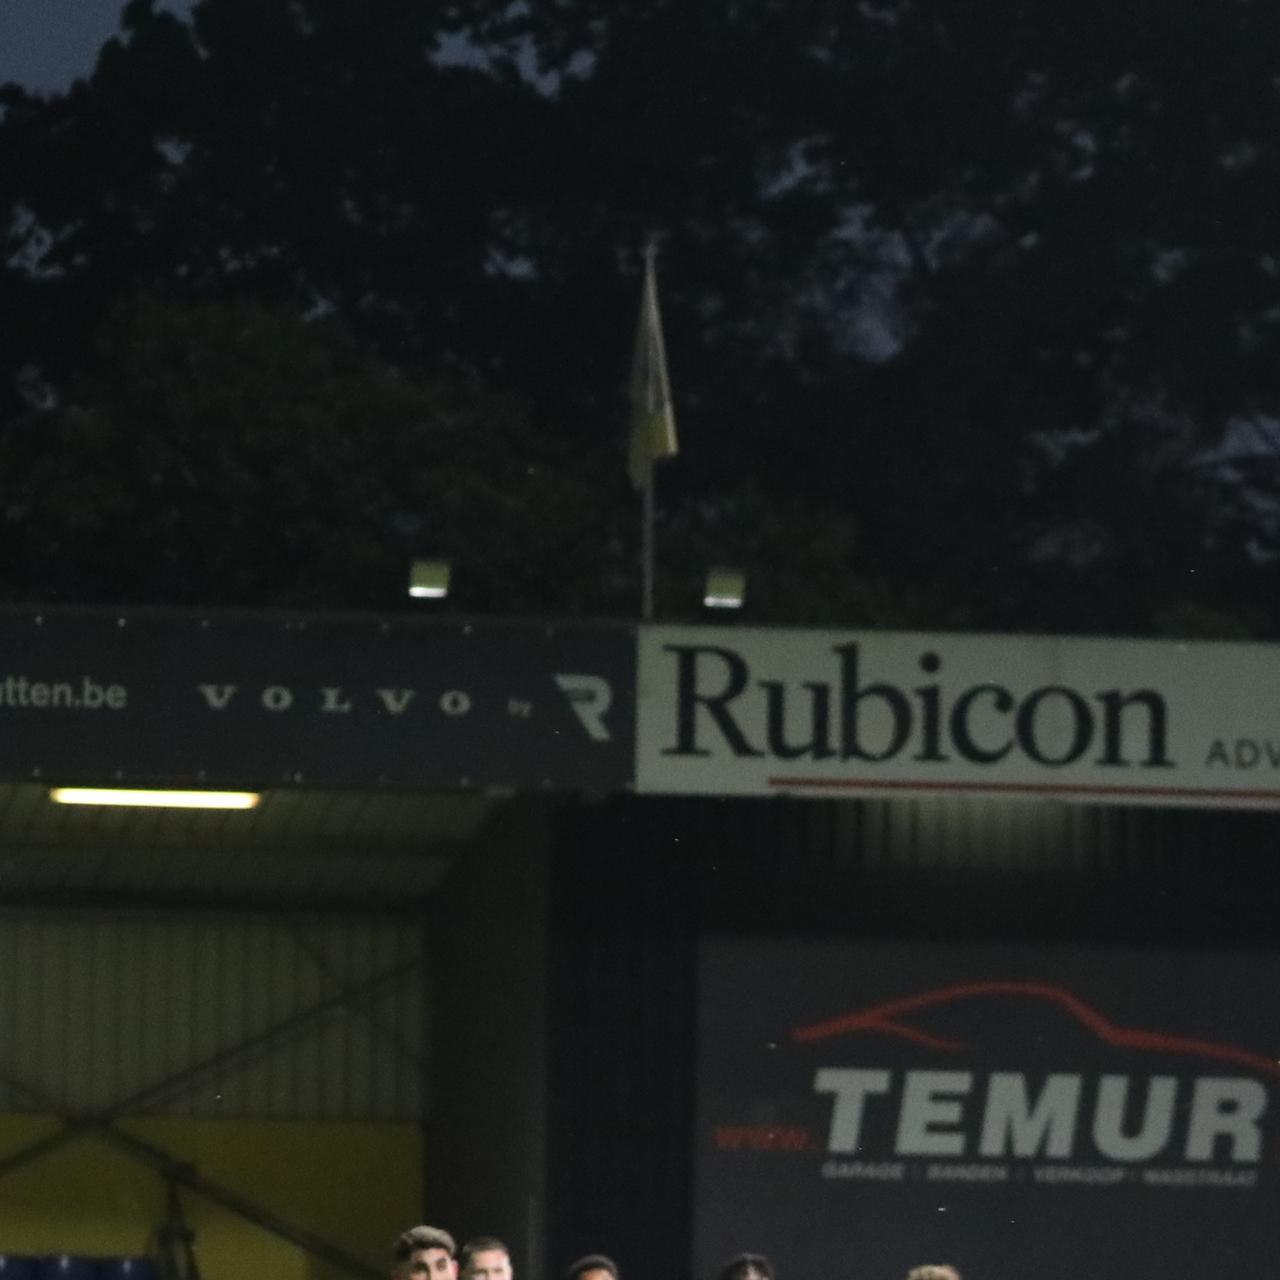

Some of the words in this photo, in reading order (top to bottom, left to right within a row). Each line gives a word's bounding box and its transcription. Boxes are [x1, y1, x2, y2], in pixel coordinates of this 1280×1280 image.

[0, 676, 127, 709] tten.be
[201, 685, 471, 716] VOLVO
[661, 642, 1175, 769] Rubicon
[814, 1068, 1268, 1163] TEMUR
